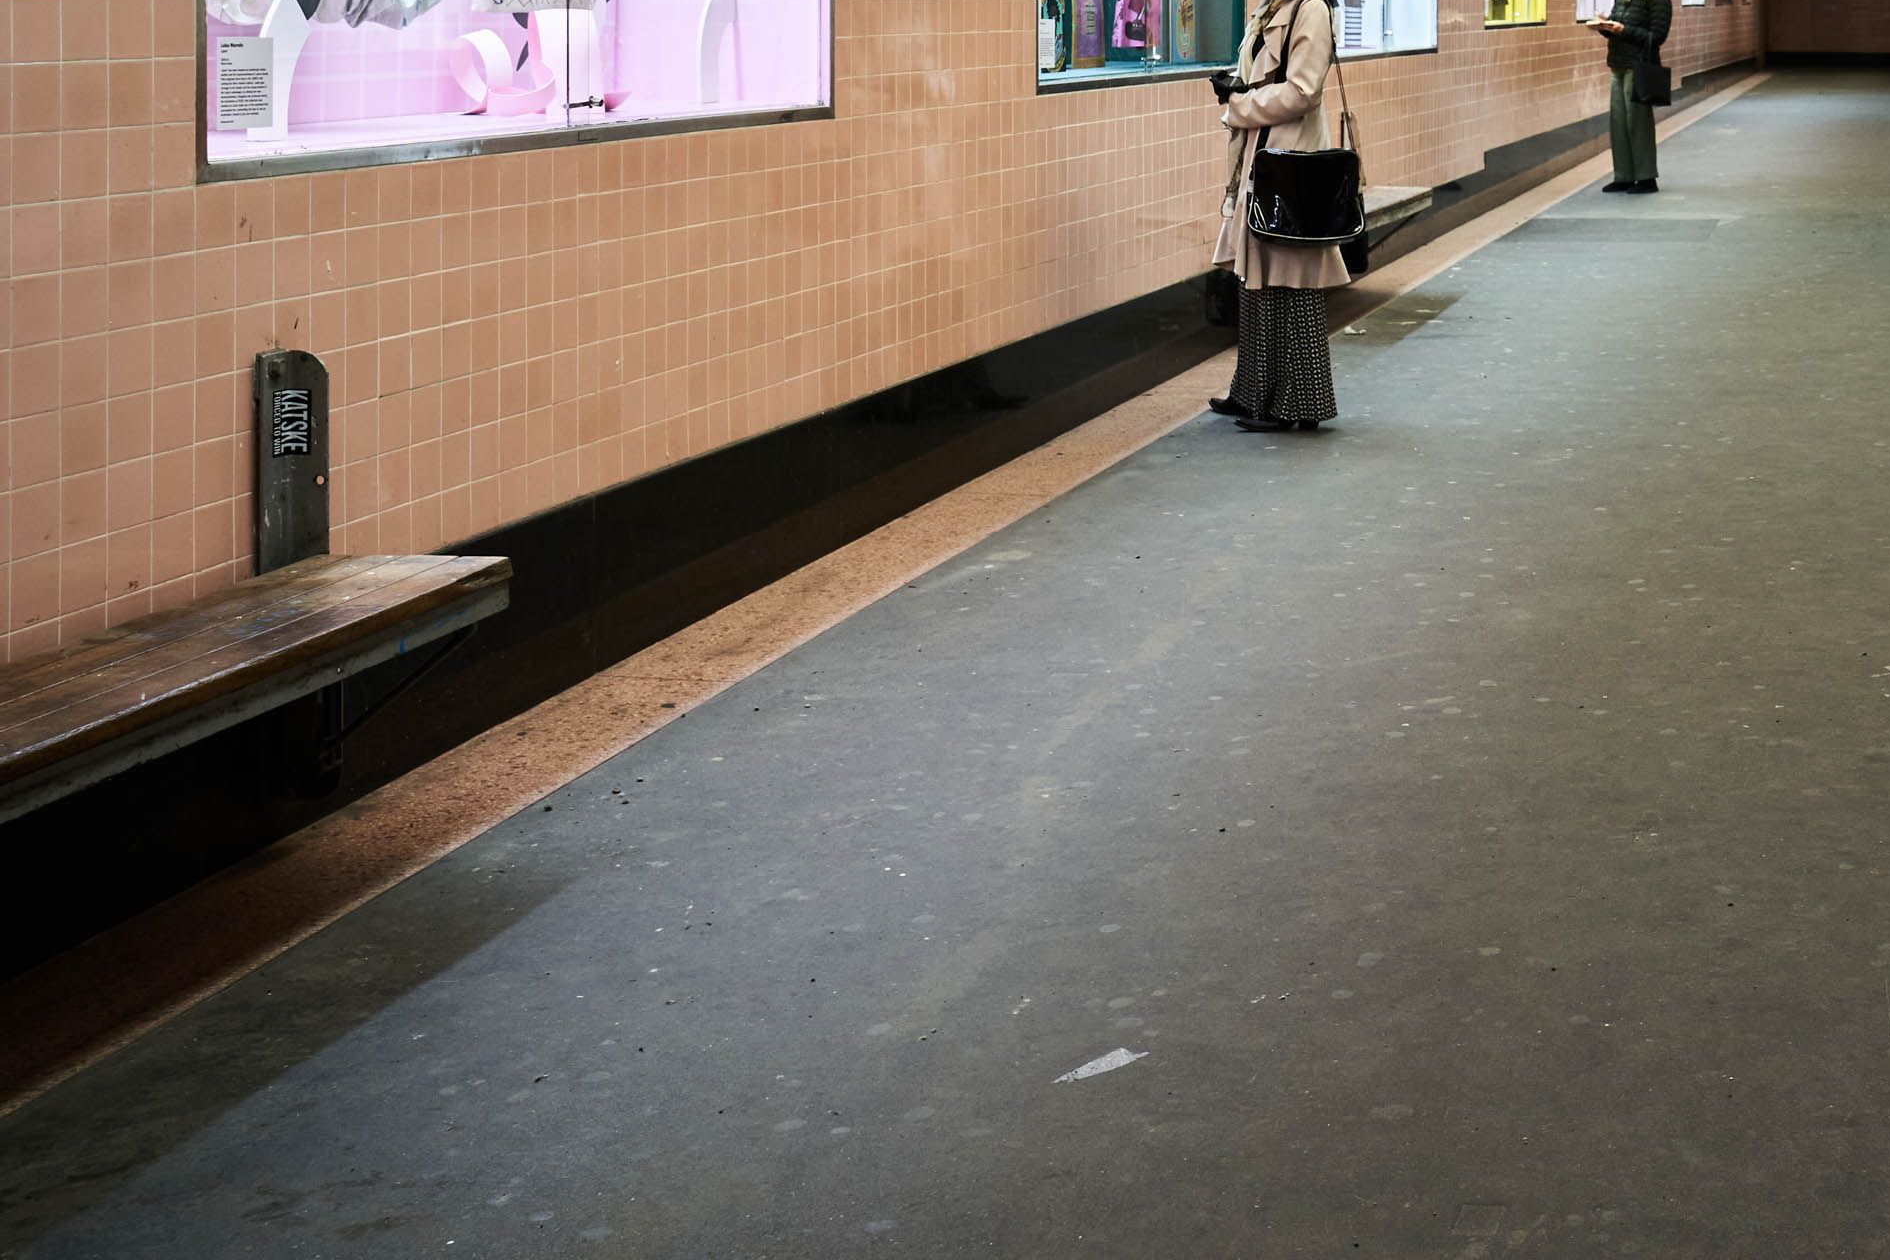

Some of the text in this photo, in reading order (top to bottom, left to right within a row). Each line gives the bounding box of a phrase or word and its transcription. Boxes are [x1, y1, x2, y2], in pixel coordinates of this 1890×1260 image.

[273, 391, 281, 455] FORCED TO WIN
[281, 389, 308, 453] KATSKE
